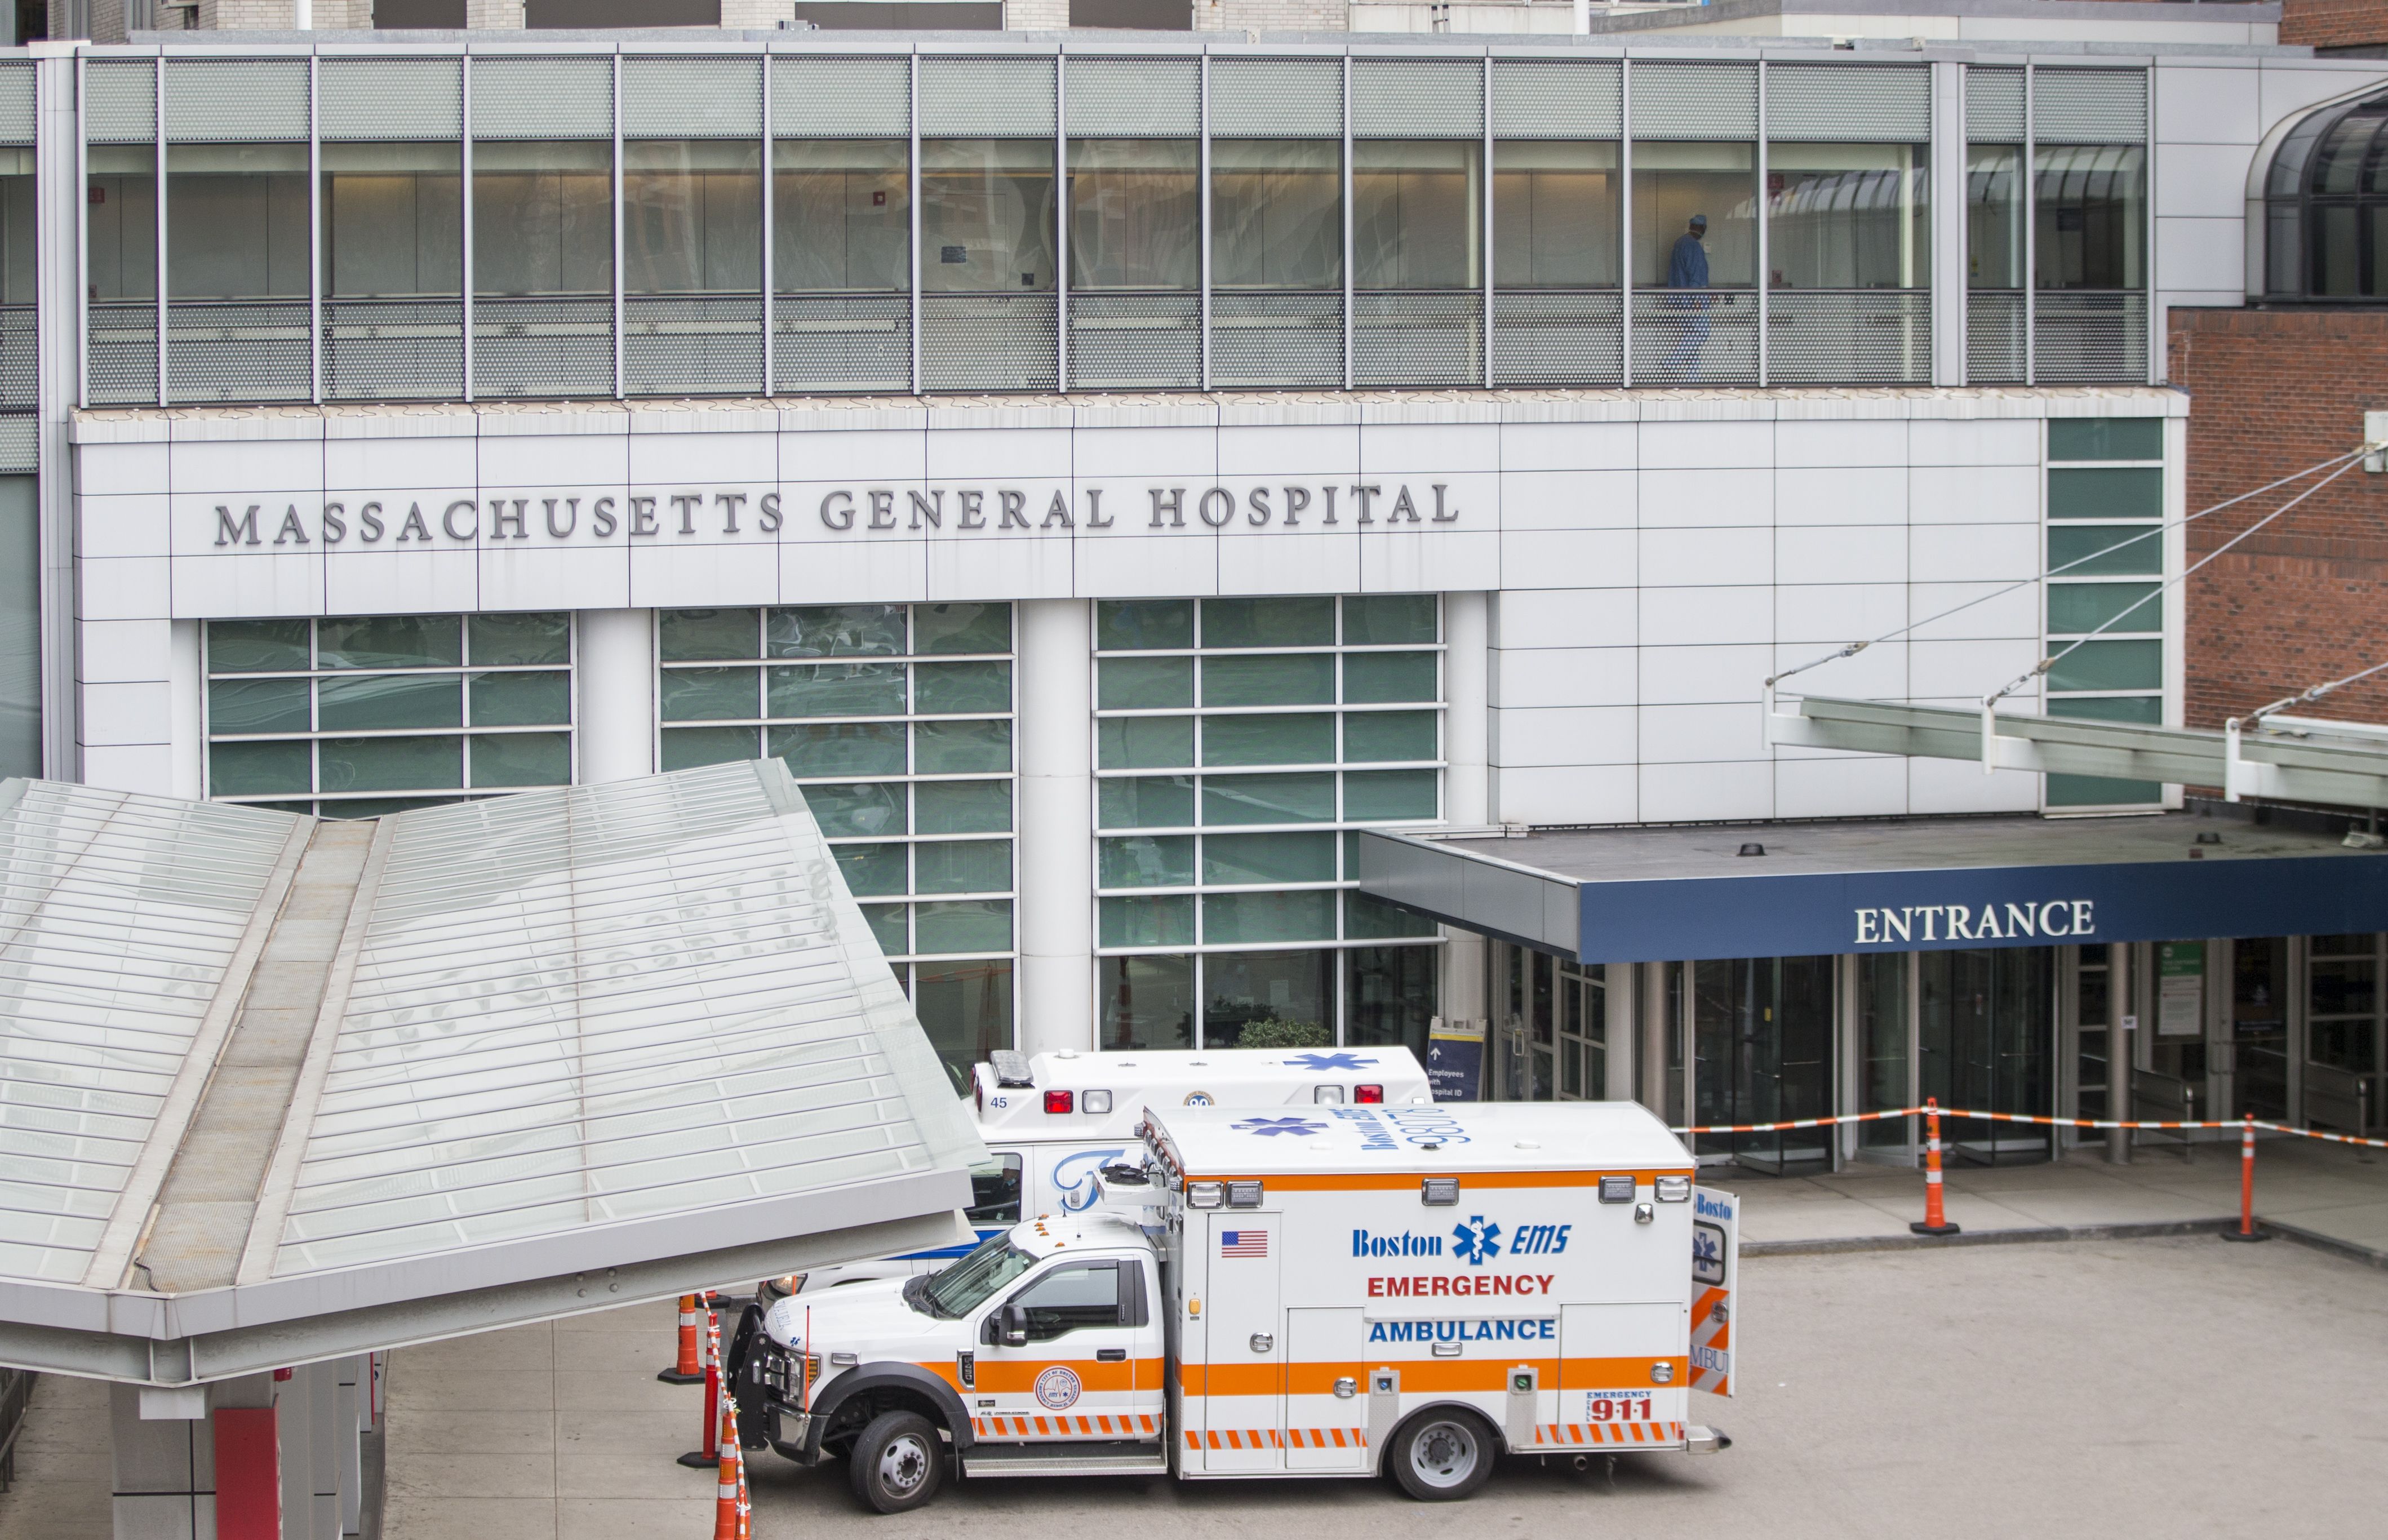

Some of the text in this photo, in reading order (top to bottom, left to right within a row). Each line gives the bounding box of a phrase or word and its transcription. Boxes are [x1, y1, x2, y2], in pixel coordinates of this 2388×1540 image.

[214, 483, 1459, 545] MASSACHUSETTS GENERAL HOSPITAL
[1853, 900, 2096, 944] ENTRANCE
[1428, 1069, 1464, 1078] Employees
[991, 1097, 1007, 1108] 45
[1432, 1088, 1453, 1097] ospital
[1697, 1193, 1733, 1222] Bosto
[1352, 1224, 1573, 1257] Boston EMS
[1368, 1275, 1555, 1298] EMERGENCY
[1369, 1319, 1555, 1343] AMBULANCE
[1690, 1344, 1729, 1373] MBU
[1586, 1391, 1652, 1399] EMERGENCY
